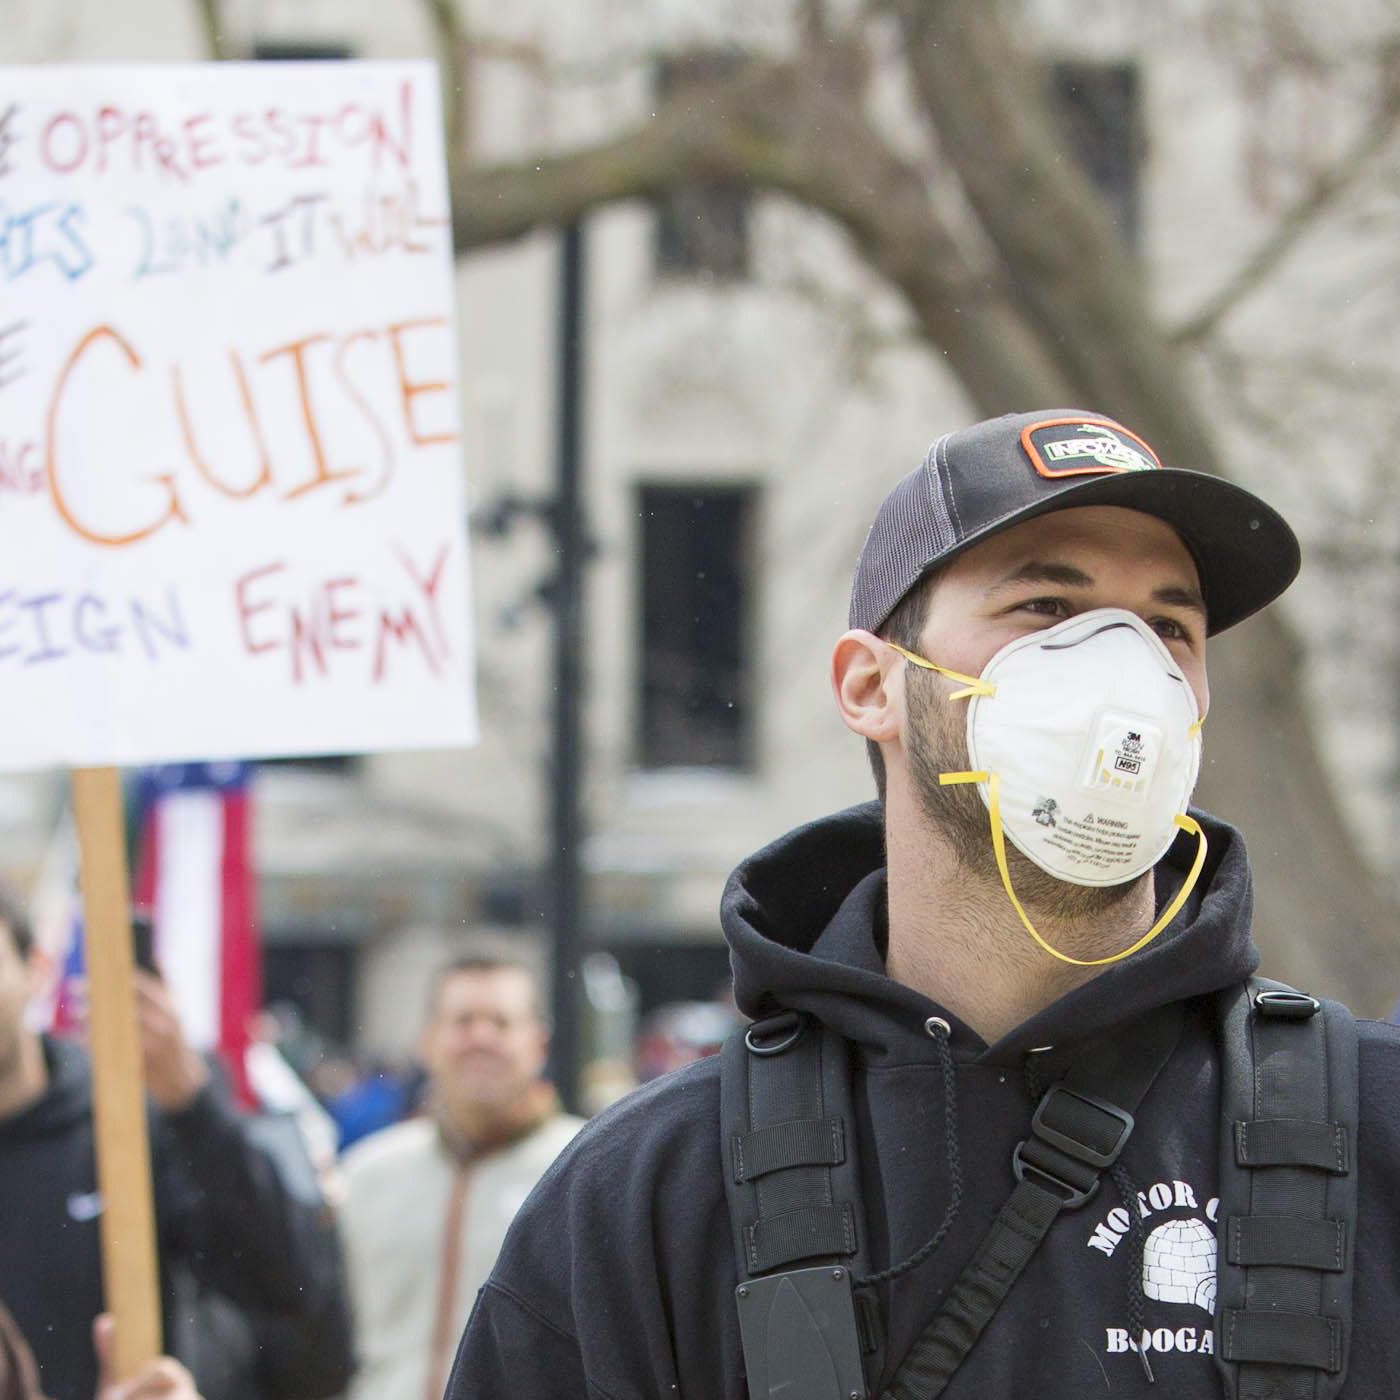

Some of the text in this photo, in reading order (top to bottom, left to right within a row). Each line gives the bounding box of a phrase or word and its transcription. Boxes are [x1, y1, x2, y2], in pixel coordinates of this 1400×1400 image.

[260, 190, 331, 273] IT
[46, 318, 462, 549] GUISE
[234, 541, 452, 686] ENEMY
[1118, 760, 1137, 771] N95
[1087, 1180, 1198, 1257] MOTOR
